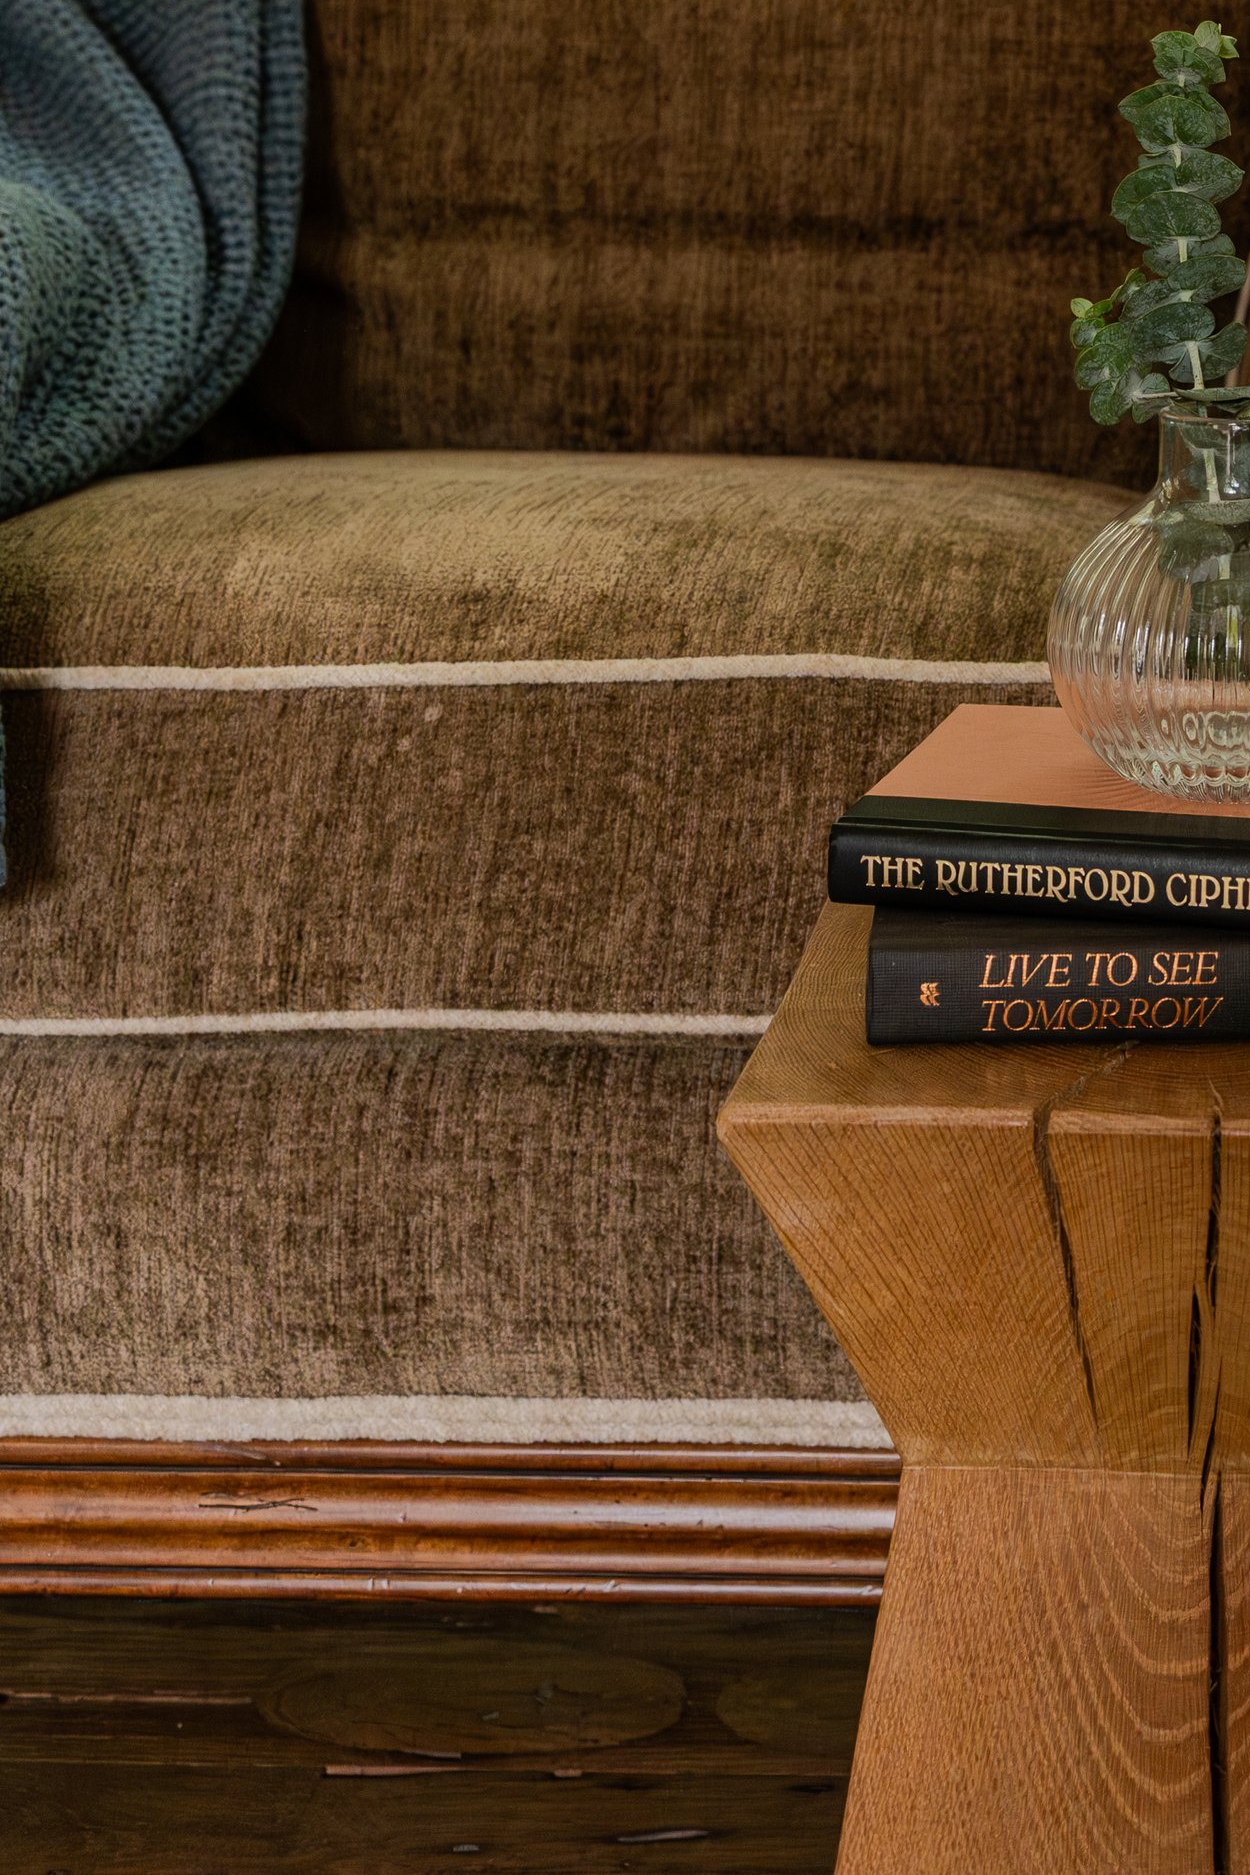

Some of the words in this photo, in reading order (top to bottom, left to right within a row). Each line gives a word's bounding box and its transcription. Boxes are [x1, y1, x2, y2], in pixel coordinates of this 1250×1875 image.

[860, 855, 924, 890] THE
[936, 859, 1155, 907] RUTHERFORD
[978, 953, 1072, 989] LIVE
[1084, 952, 1138, 986] TO
[1147, 951, 1219, 986] SEE
[981, 996, 1224, 1032] TOMORROW
